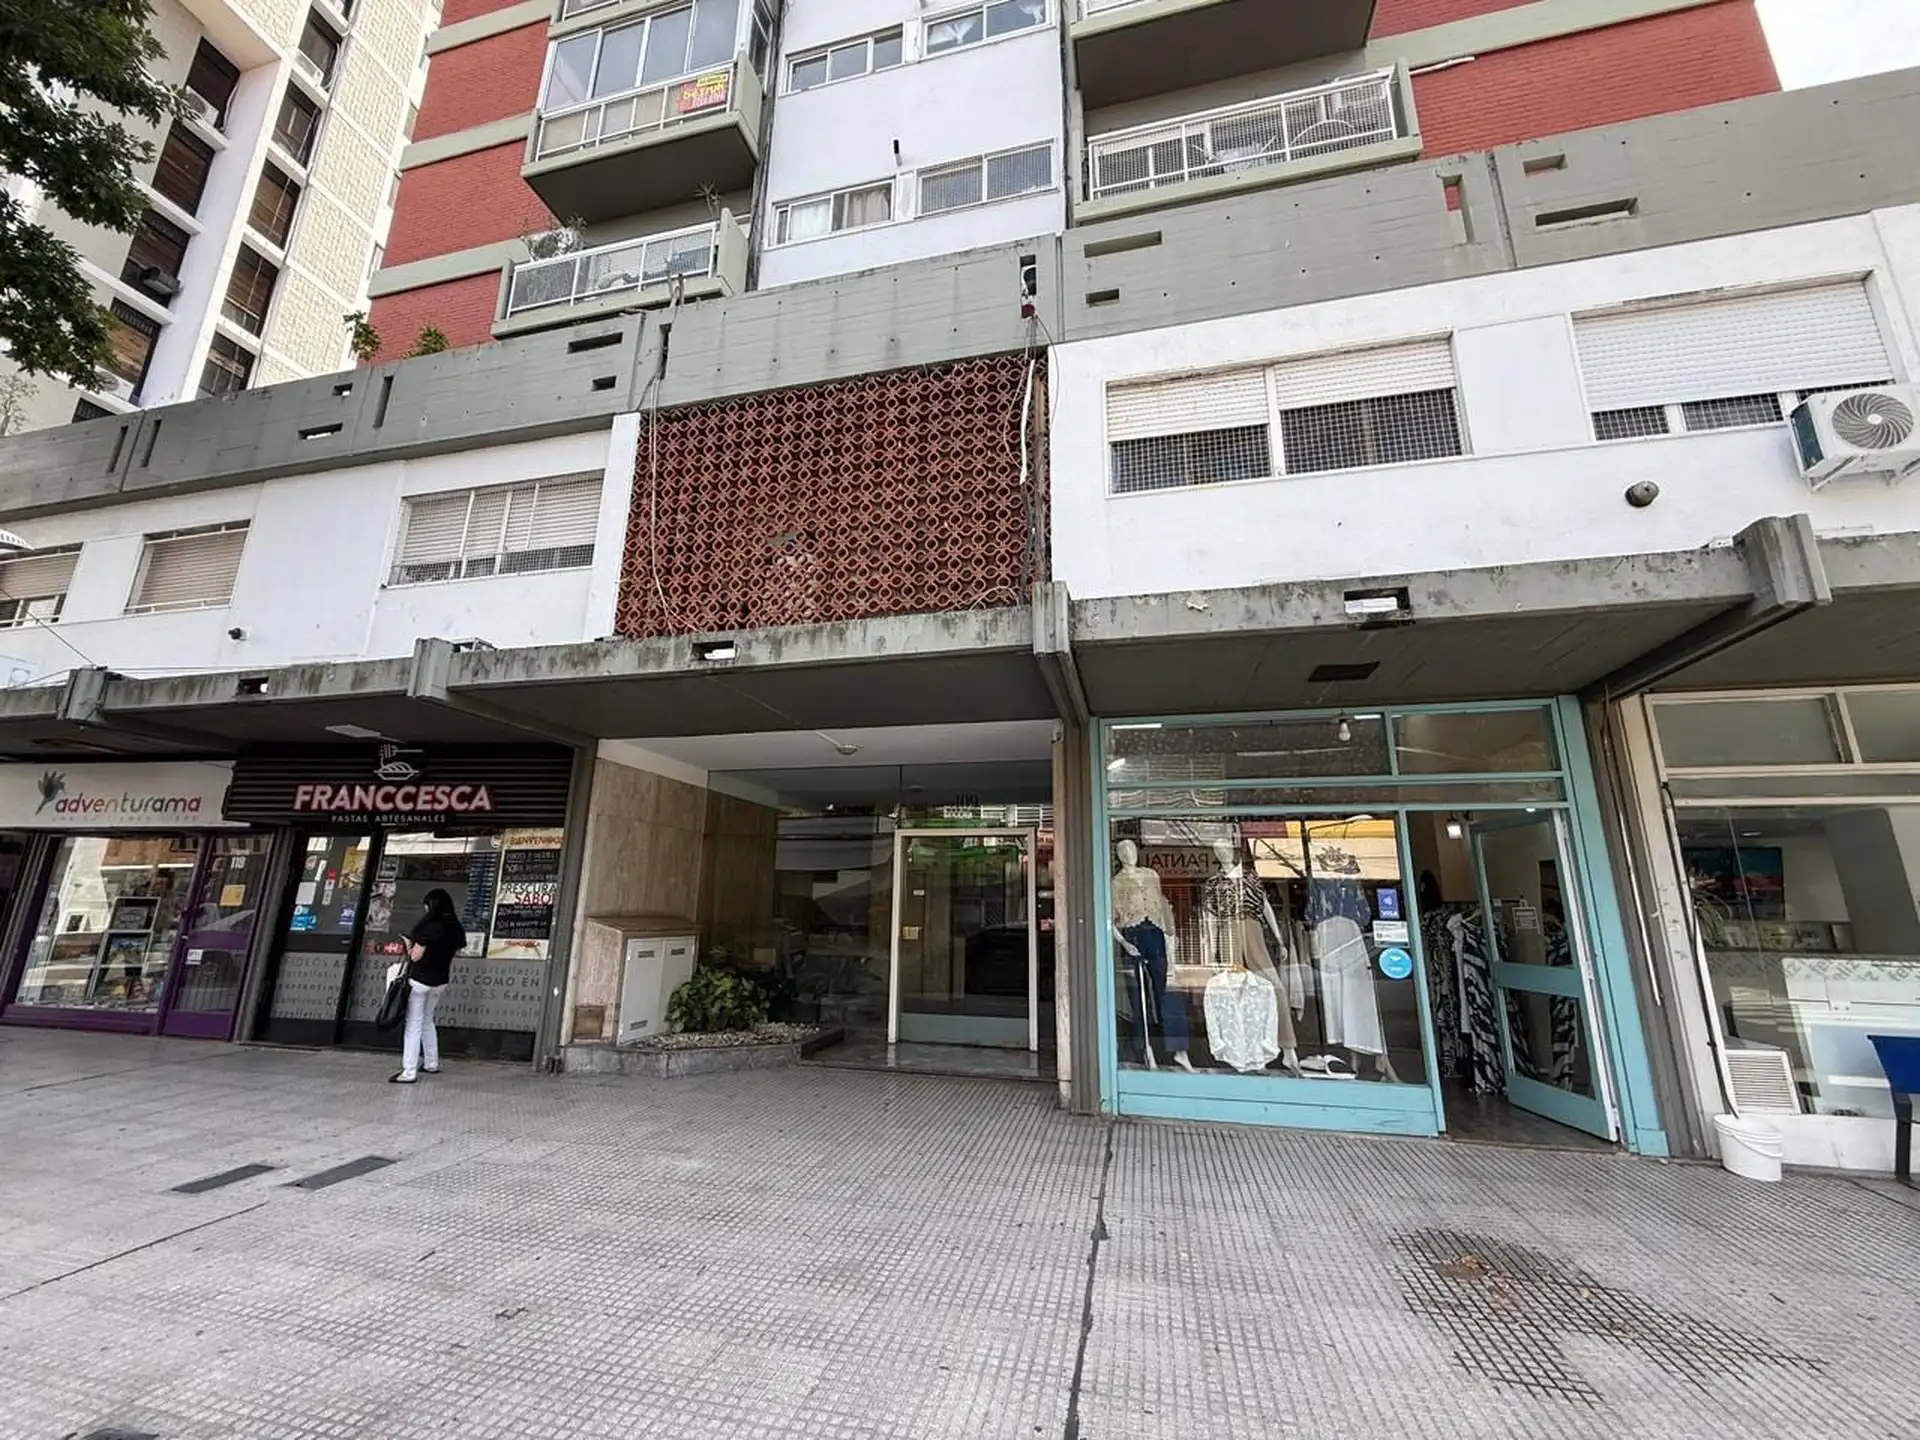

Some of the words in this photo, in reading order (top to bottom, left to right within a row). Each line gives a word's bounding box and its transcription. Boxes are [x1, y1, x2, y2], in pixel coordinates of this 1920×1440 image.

[55, 792, 202, 813] adventurama
[293, 785, 492, 811] FRANCCESCA
[331, 814, 368, 823] PASTAS
[473, 976, 515, 987] COMO
